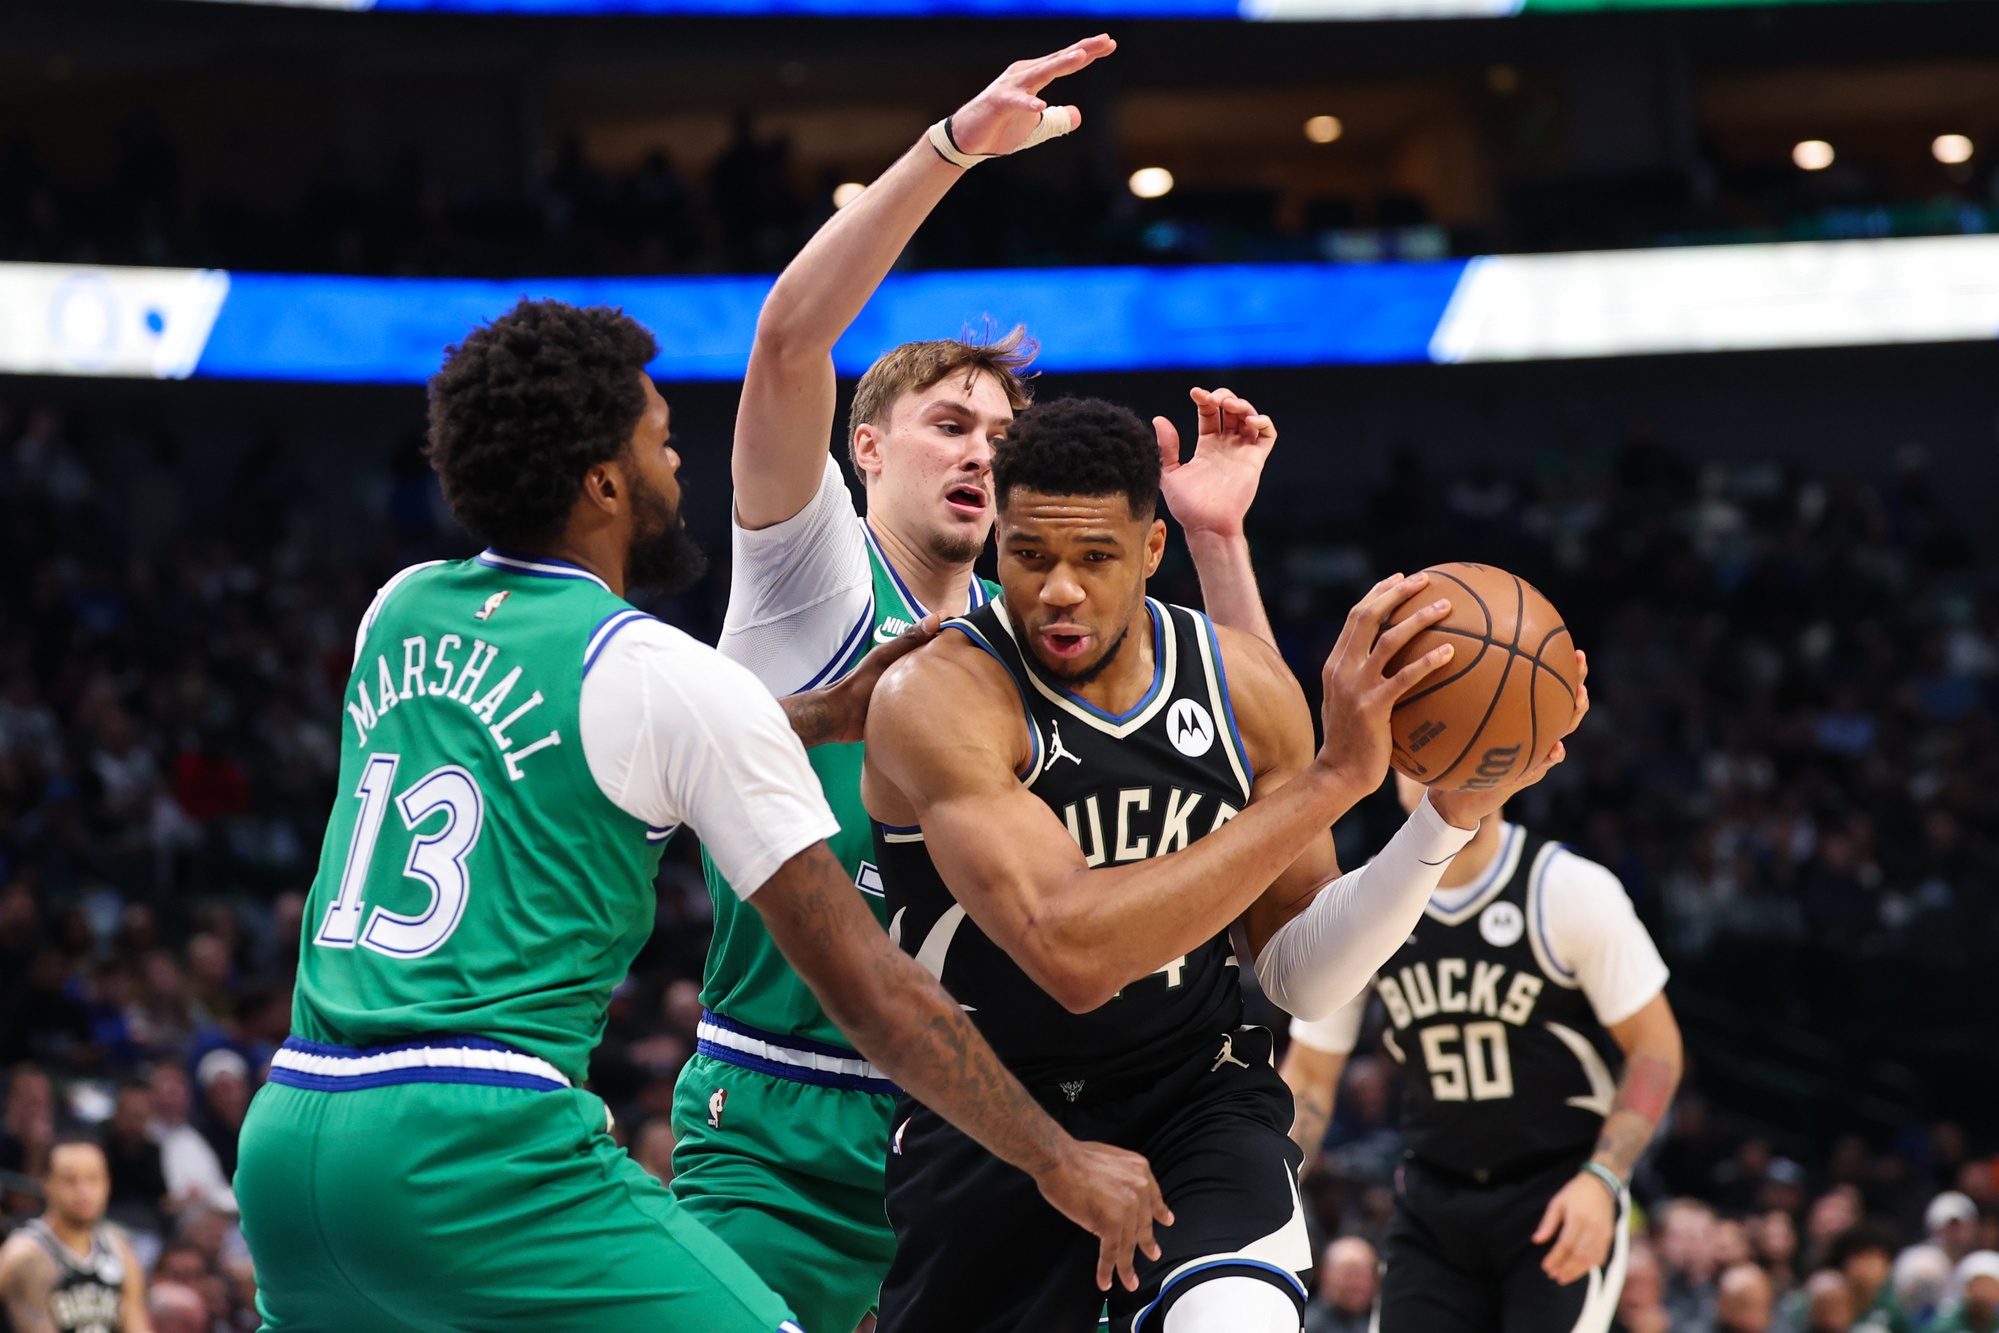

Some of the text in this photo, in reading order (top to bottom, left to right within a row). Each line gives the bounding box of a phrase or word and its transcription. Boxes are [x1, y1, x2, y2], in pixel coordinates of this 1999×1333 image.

[881, 616, 913, 635] NIK
[347, 634, 561, 781] MARSHALL
[314, 753, 484, 959] 13
[1064, 787, 1239, 868] UCK
[1377, 959, 1543, 1029] BUCKS
[1420, 1022, 1513, 1101] 50
